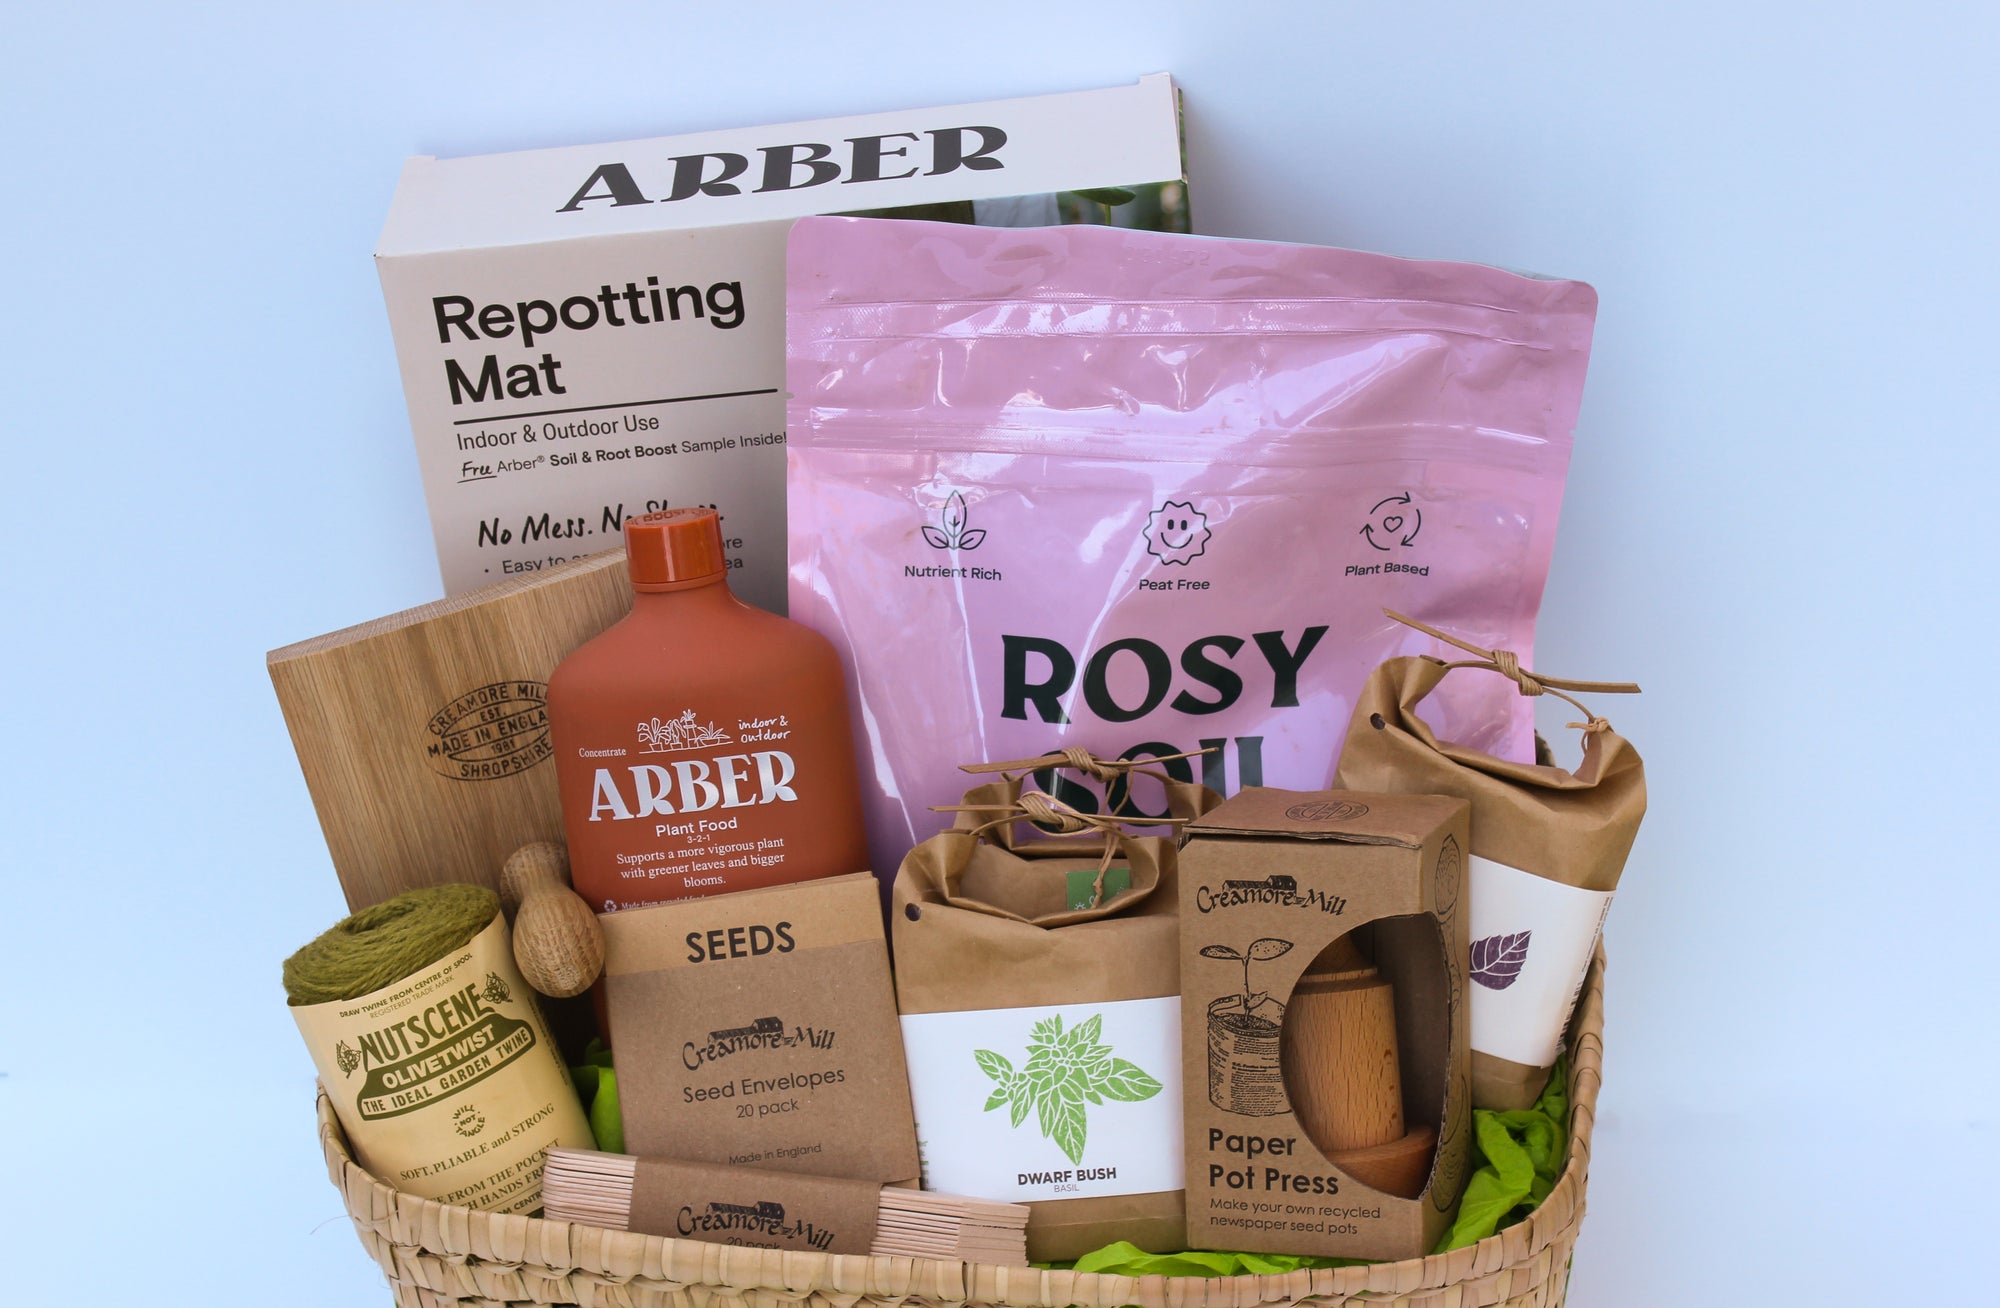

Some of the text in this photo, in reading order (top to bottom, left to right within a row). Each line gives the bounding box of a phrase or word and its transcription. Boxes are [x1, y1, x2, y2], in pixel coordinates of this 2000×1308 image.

[556, 125, 1008, 213] ARBER
[432, 276, 745, 348] Repotting
[444, 353, 567, 405] Mat
[456, 414, 660, 451] Indoor & Outdoor Use
[461, 461, 493, 478] Free
[549, 452, 577, 466] Soil
[581, 451, 592, 463] &
[595, 447, 631, 462] Root
[634, 443, 678, 458] Boost
[681, 437, 736, 455] Sample
[740, 431, 788, 448] Inside!
[478, 517, 512, 548] No
[521, 512, 593, 544] Mess.
[601, 503, 633, 534] N
[904, 565, 1002, 582] Nutrient Rich
[1345, 561, 1429, 577] Plant Based
[1139, 578, 1210, 592] Peat Free
[1000, 625, 1330, 725] ROSY
[429, 684, 548, 737] CREAMORE MIL
[480, 707, 507, 722] EST.
[738, 715, 788, 730] indoor &
[427, 710, 548, 758] MADE IN ENGLA
[740, 730, 791, 743] outdoor
[461, 737, 553, 777] SHROPSHIRE
[578, 747, 627, 758] Concentrate
[588, 750, 798, 821] ARBER
[655, 817, 738, 837] Plant Food
[687, 834, 710, 844] 3-2-1
[616, 850, 665, 865] Supports
[677, 847, 705, 858] more
[708, 842, 754, 856] vigorous
[757, 838, 785, 850] plant
[621, 853, 785, 879] with greener leaves and bigger
[684, 875, 726, 888] blooms.
[1196, 885, 1347, 916] Creamore Mill
[685, 921, 796, 963] SEEDS
[339, 952, 473, 1018] DRAW TWINE FROM CENTRE OF SPOOL
[370, 976, 455, 1019] REGISTERED TRADE MARK
[357, 983, 495, 1072] NUTSCENE
[382, 1023, 495, 1089] OLIVETWIST
[682, 1026, 836, 1071] Creamore Mill
[363, 1028, 529, 1113] THE IDEAL GARDEN TWINE
[683, 1069, 845, 1103] Seed Envelopes
[452, 1104, 476, 1120] WILL
[459, 1114, 476, 1127] NOT
[735, 1098, 799, 1118] 20 pack
[400, 1102, 555, 1181] SOFT, PLIABLE and STRONG
[455, 1116, 486, 1137] TANGLE
[729, 1143, 822, 1165] Made in England
[1208, 1128, 1297, 1159] Paper
[447, 1181, 486, 1203] FROM
[487, 1167, 515, 1186] THE
[515, 1138, 559, 1172] POCKT
[1017, 1167, 1117, 1186] DWARF BUSH
[1209, 1164, 1339, 1195] Pot Press
[479, 1178, 523, 1206] HANDS
[514, 1189, 543, 1210] CENTR
[1053, 1184, 1080, 1193] BASIL
[1210, 1198, 1381, 1219] Make your own recycled
[676, 1205, 836, 1250] Creamore Mill
[1210, 1215, 1358, 1235] newspaper seed pots
